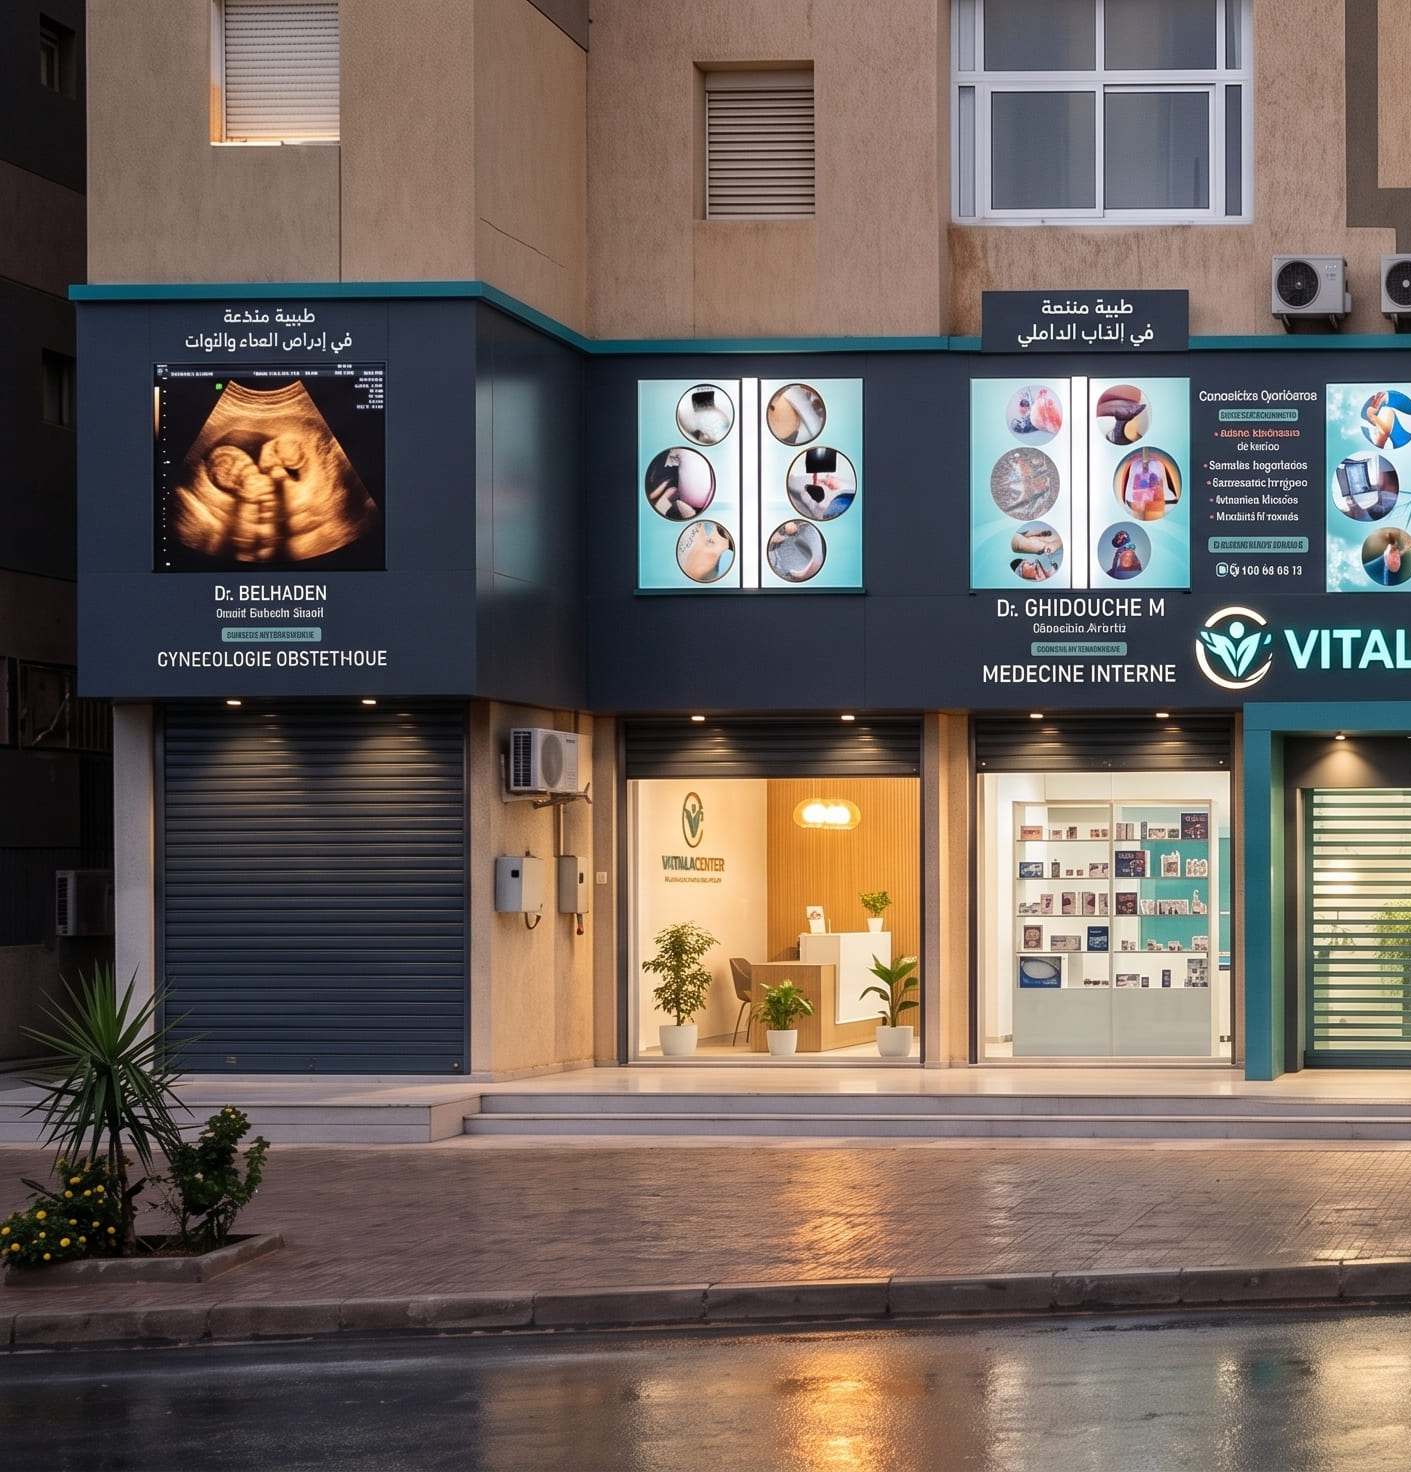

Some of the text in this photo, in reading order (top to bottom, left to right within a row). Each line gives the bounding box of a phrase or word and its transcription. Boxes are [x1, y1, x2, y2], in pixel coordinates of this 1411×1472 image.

[331, 332, 352, 353] في
[1130, 324, 1153, 346] في
[215, 585, 326, 600] Dr. BELHADEN
[998, 598, 1164, 616] Dr. GHIDOUCHE M
[983, 665, 1176, 682] MEDECINE INTERNE
